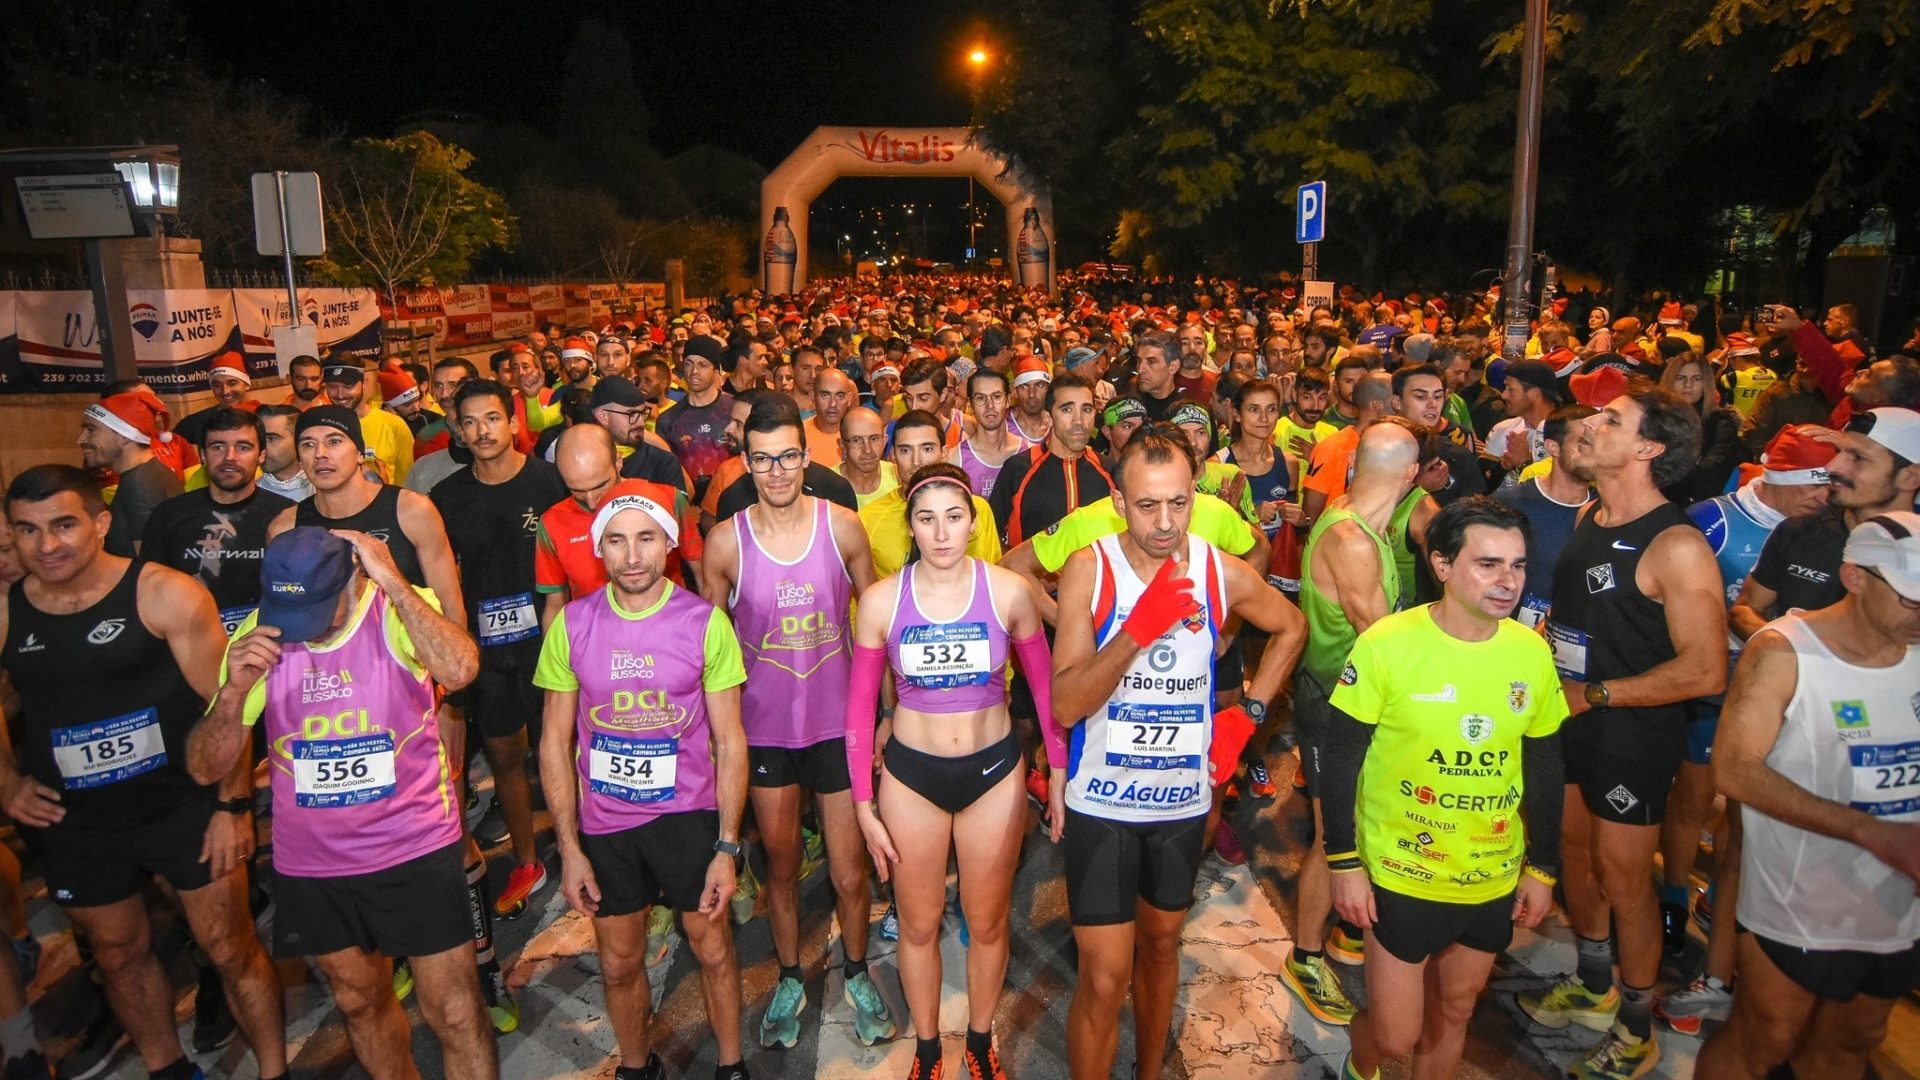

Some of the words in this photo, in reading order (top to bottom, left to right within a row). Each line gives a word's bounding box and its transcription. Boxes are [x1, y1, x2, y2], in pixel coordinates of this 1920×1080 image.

[858, 129, 955, 162] Vitalis
[1301, 189, 1318, 238] P
[167, 306, 222, 325] JUNTE-SE
[322, 301, 359, 315] JUNTE-SE
[323, 320, 331, 329] A
[333, 314, 351, 328] NÓS!
[170, 329, 184, 343] A
[188, 321, 216, 340] NÓS!
[43, 373, 65, 383] 239
[69, 373, 90, 383] 702
[522, 512, 539, 532] 75
[777, 587, 805, 600] LUSO
[486, 610, 518, 628] 794
[923, 644, 967, 664] 532
[612, 658, 645, 671] LUSO
[942, 663, 974, 671] ASSUNÇÃO
[303, 675, 341, 693] LUSO
[302, 687, 353, 704] BUSSACO
[1132, 725, 1180, 745] 277
[80, 735, 134, 763] 185
[97, 753, 137, 767] RODRIGUES
[610, 756, 652, 778] 554
[317, 757, 368, 782] 556
[608, 774, 628, 783] MANUEL
[1439, 766, 1502, 777] PEDRALVA
[342, 777, 375, 788] GODINHO
[1087, 777, 1117, 796] RD
[1119, 780, 1200, 803] ÁGUEDA
[1084, 795, 1107, 805] AMAMOS
[1405, 810, 1457, 830] MIRANDA
